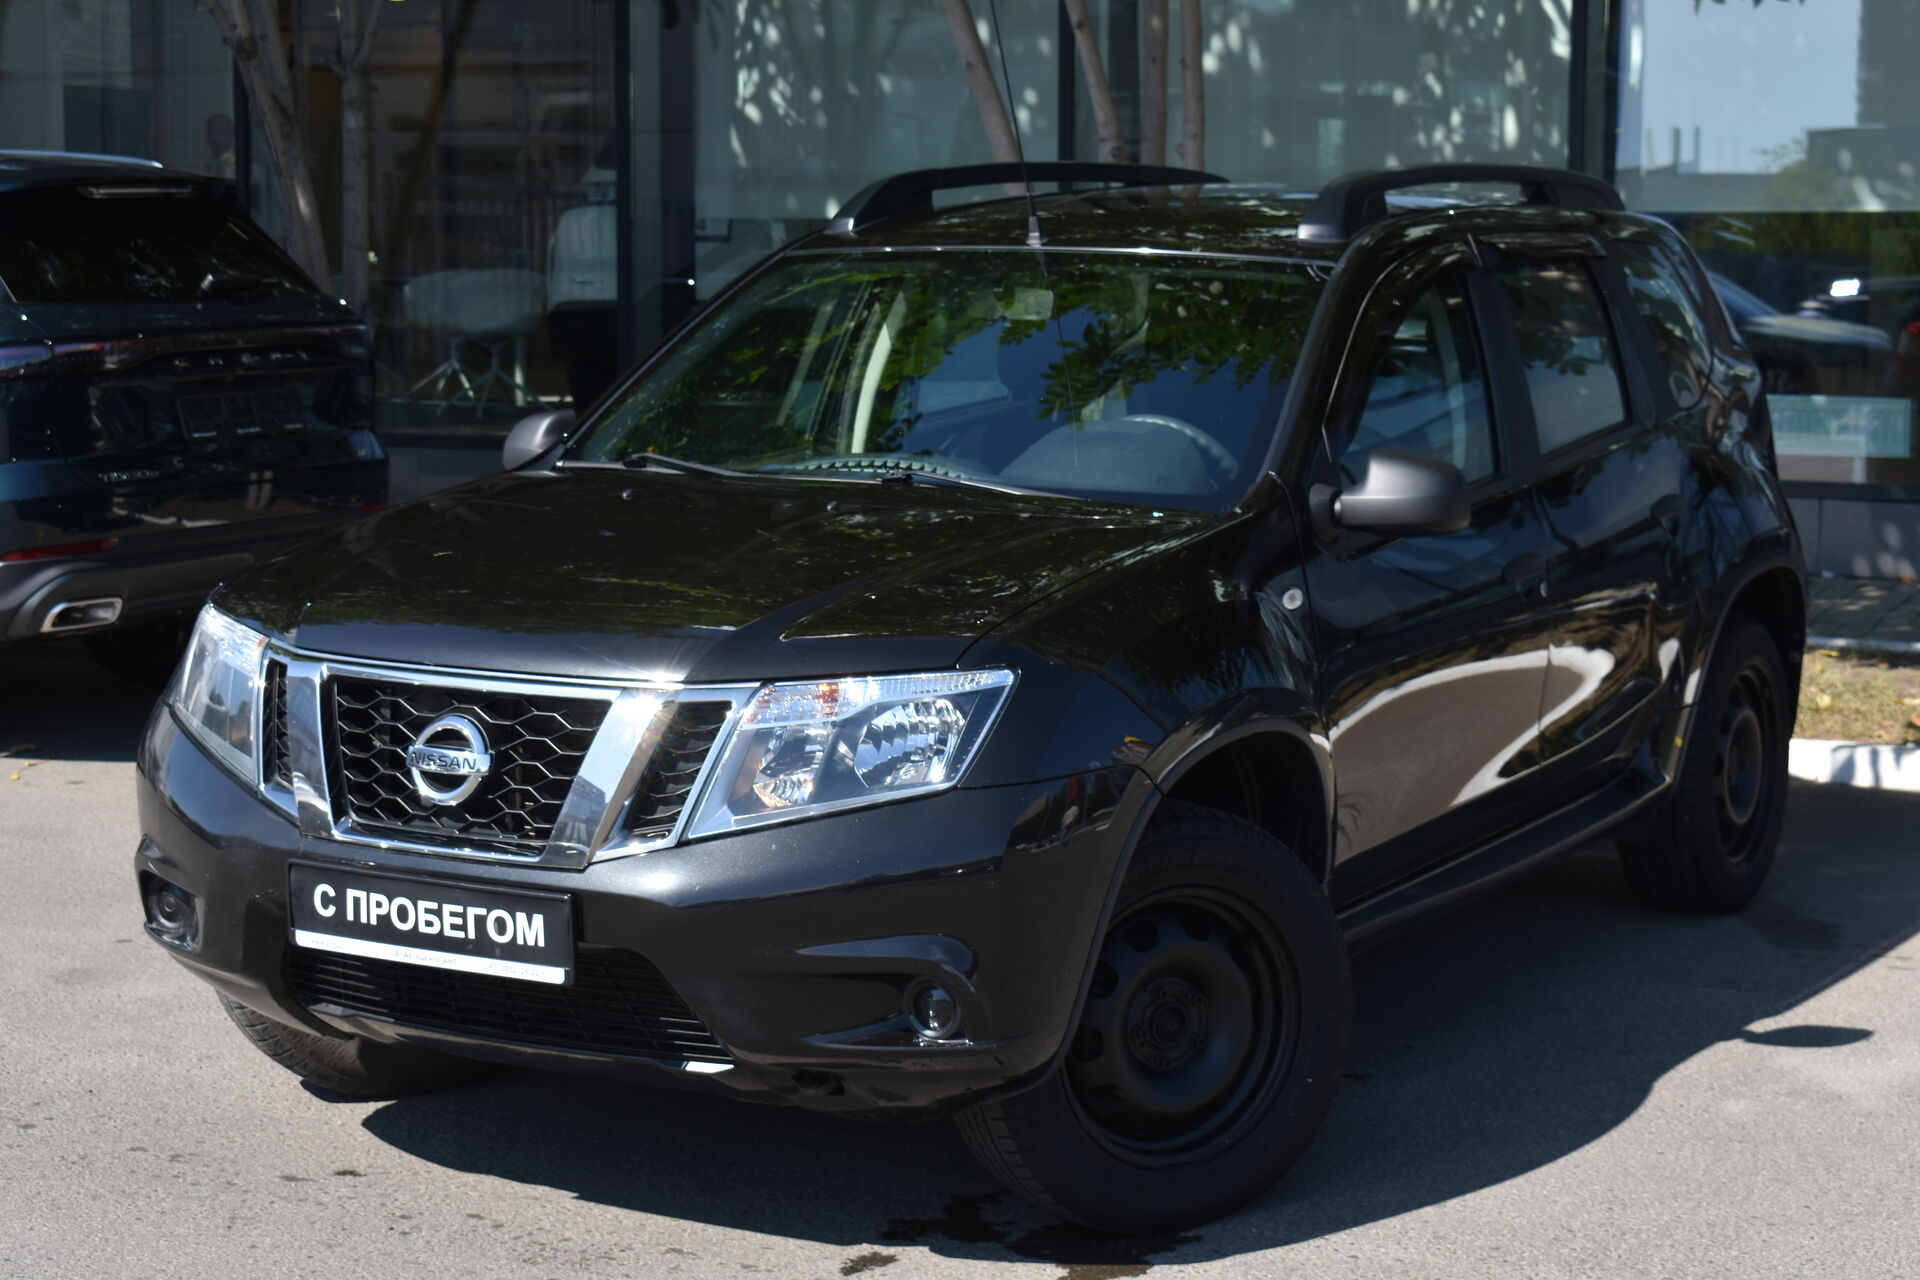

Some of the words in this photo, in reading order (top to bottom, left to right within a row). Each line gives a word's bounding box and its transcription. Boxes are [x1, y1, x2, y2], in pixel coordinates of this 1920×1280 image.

[410, 751, 477, 771] NISSAN
[313, 883, 336, 918] С
[346, 887, 546, 948] ПРОБЕГОМ
